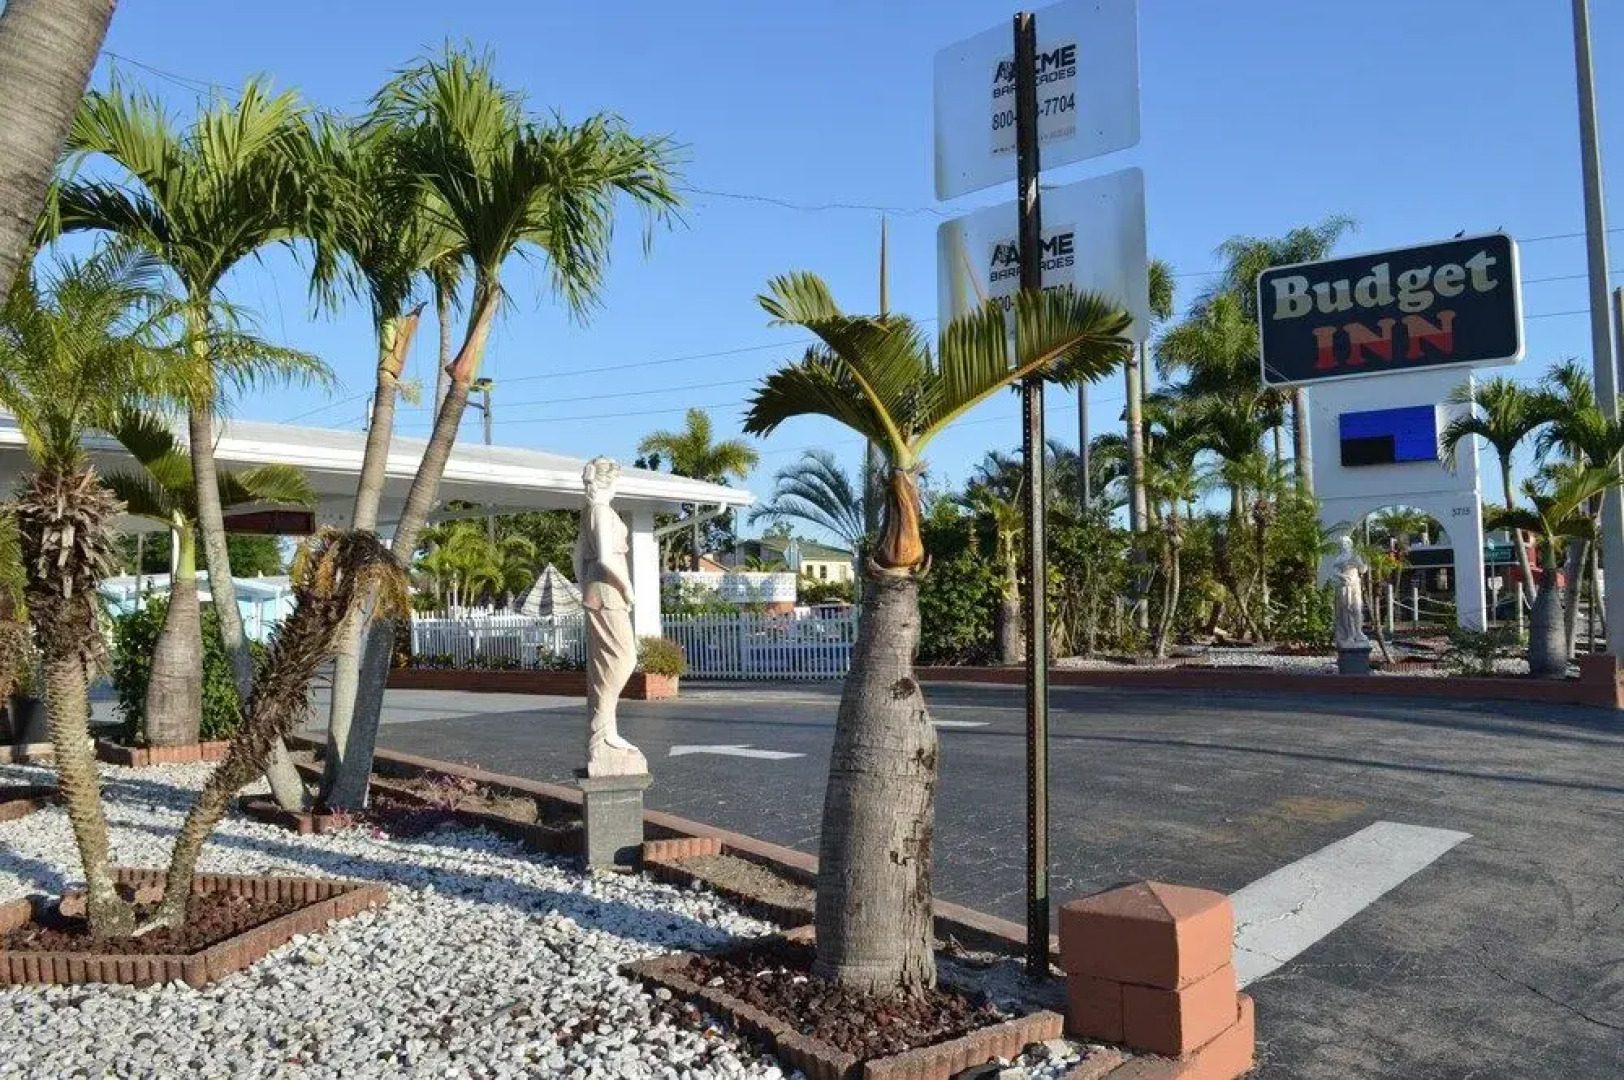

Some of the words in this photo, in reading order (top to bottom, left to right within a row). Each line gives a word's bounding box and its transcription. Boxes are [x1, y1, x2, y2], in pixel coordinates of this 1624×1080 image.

[991, 92, 1076, 130] 800--7704
[1270, 250, 1499, 320] Budget
[1312, 309, 1456, 370] INN
